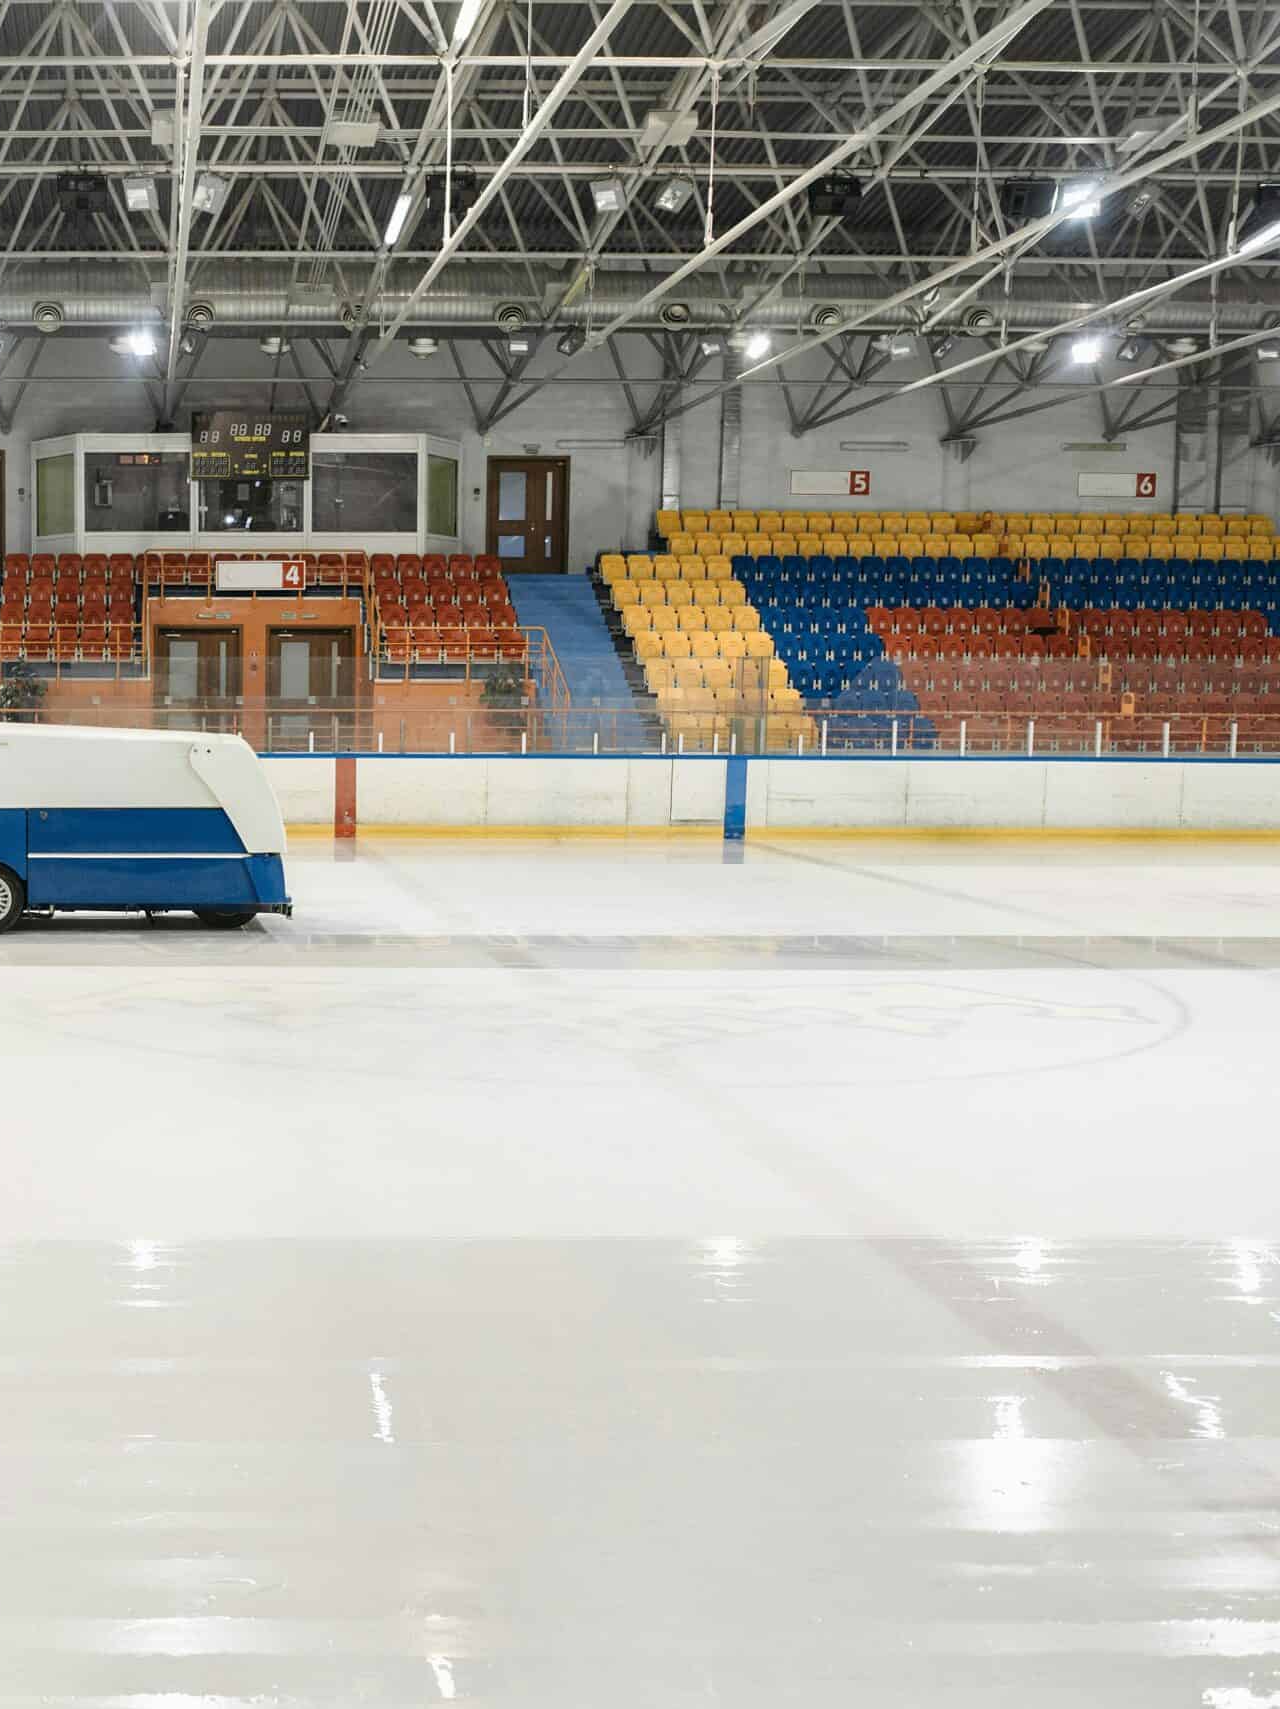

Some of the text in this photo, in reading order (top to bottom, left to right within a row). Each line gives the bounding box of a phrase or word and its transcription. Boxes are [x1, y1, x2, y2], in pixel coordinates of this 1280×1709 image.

[854, 474, 867, 492] 5
[1140, 476, 1152, 494] 6
[285, 565, 299, 585] 4
